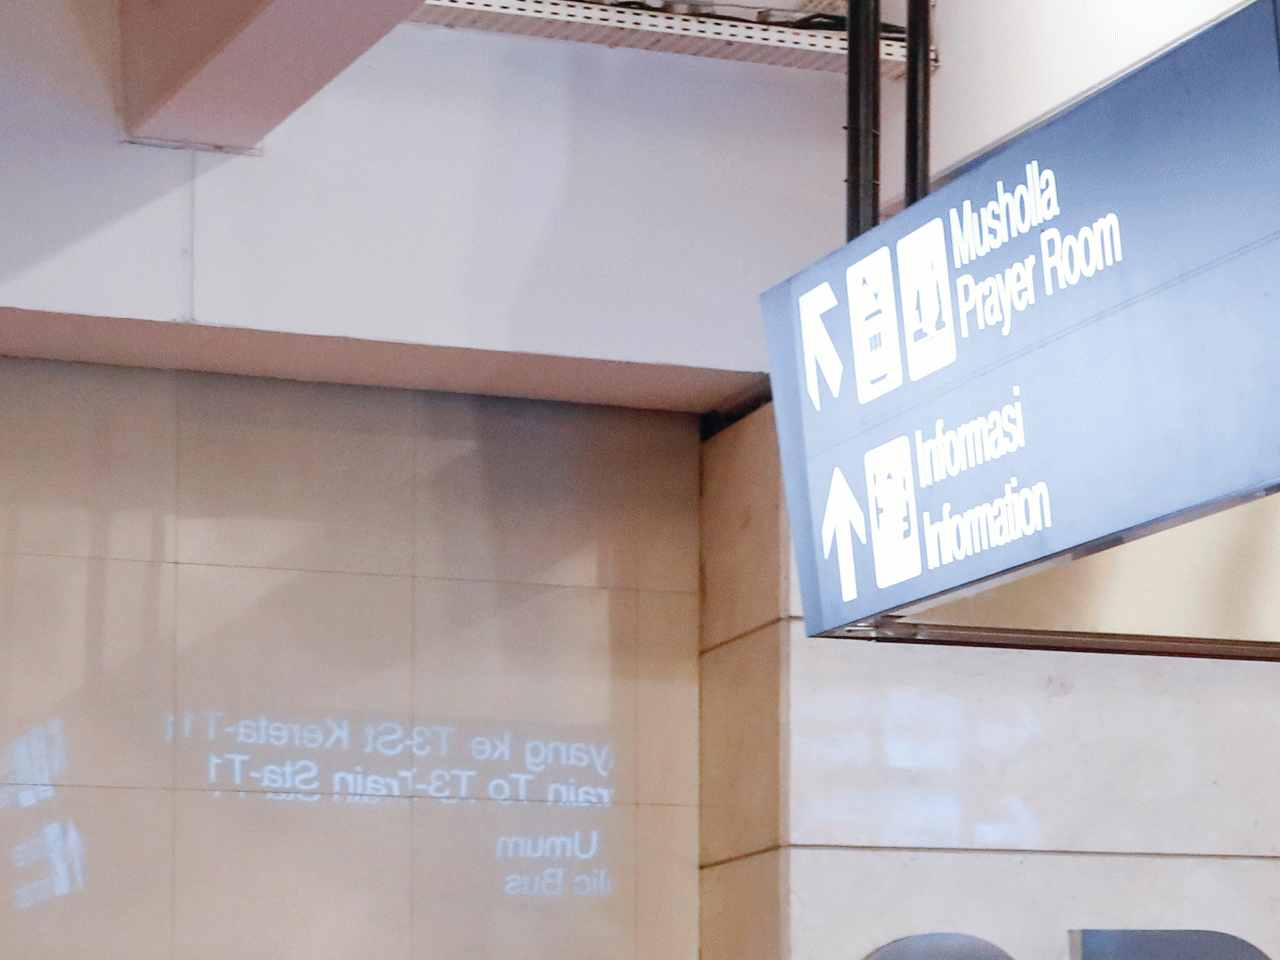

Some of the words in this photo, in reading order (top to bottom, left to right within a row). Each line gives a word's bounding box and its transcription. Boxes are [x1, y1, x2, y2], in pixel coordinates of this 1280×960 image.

[949, 160, 1060, 268] Musholla
[956, 254, 1036, 337] Prayer
[1040, 213, 1123, 295] Room
[915, 385, 1025, 488] Informasi
[923, 476, 1052, 570] Information
